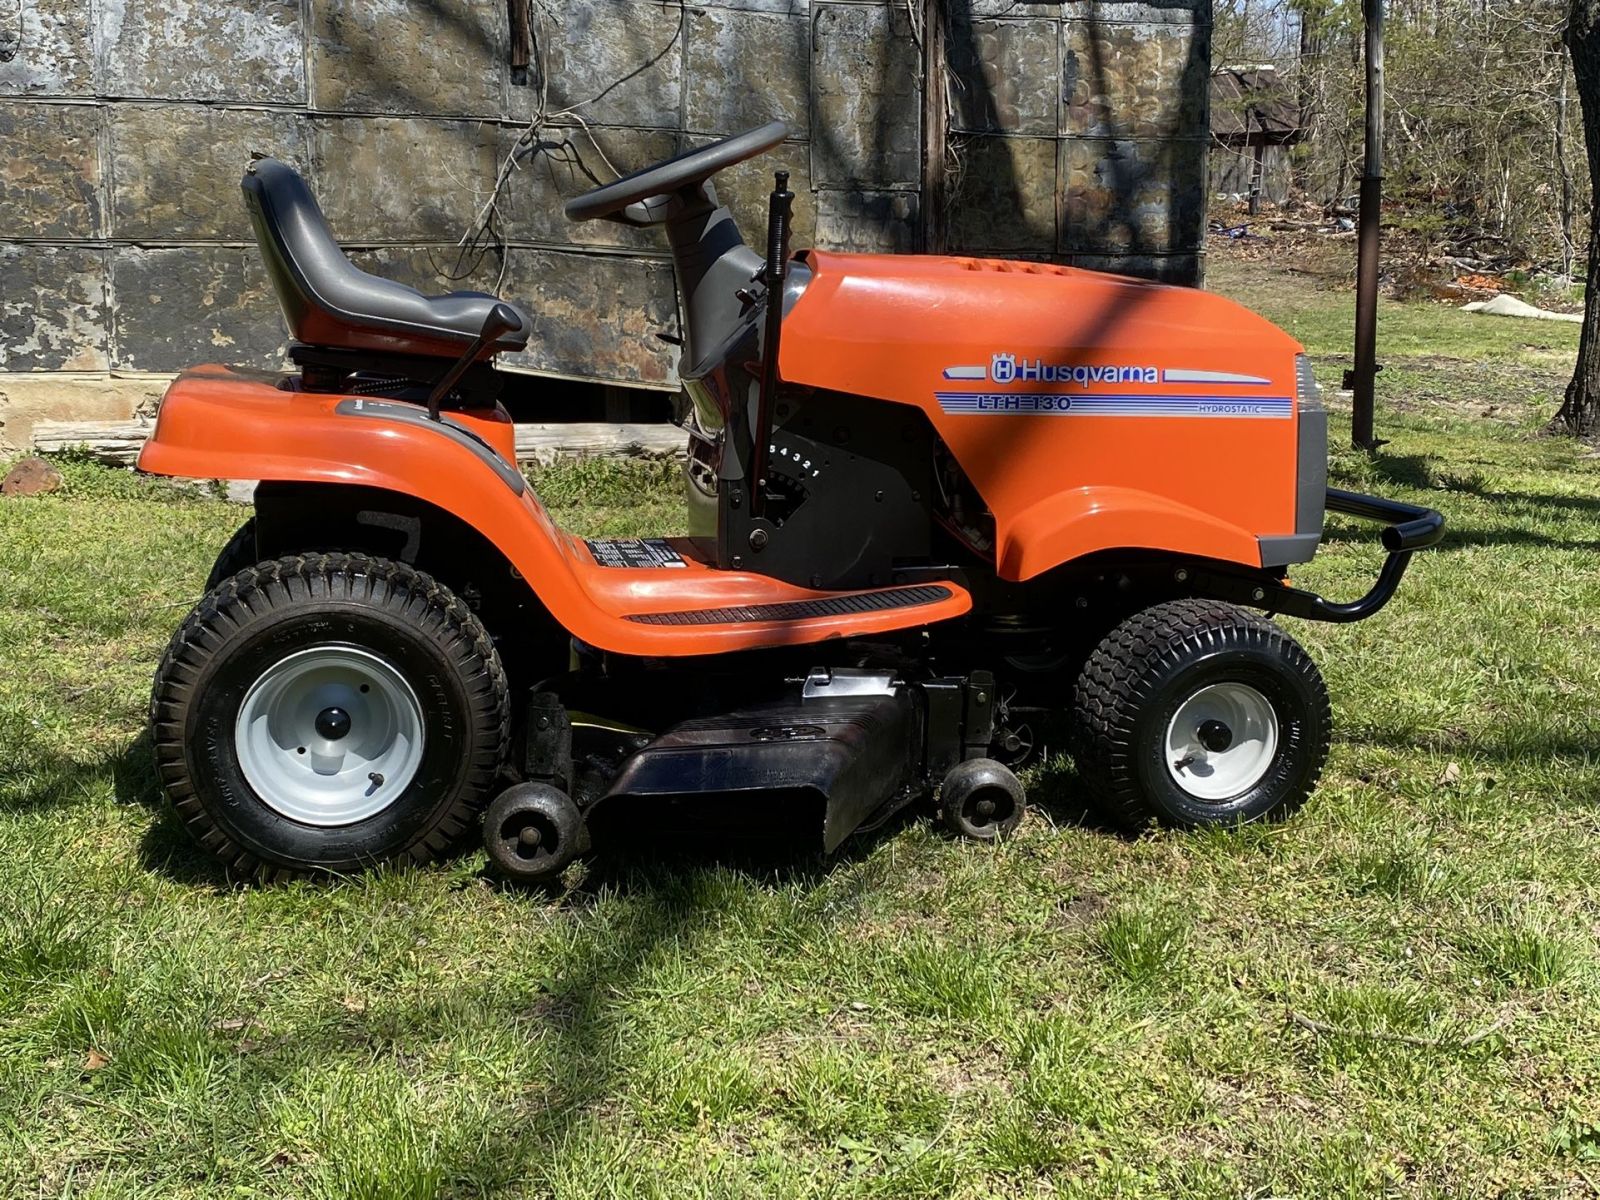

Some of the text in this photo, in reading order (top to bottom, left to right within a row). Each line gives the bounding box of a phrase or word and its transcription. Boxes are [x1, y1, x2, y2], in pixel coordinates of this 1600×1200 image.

[1022, 359, 1159, 388] Husqvarna
[977, 396, 1072, 411] LTH 130
[1198, 404, 1262, 414] HYDROSTATIC
[793, 453, 800, 462] 3
[802, 460, 811, 468] 2
